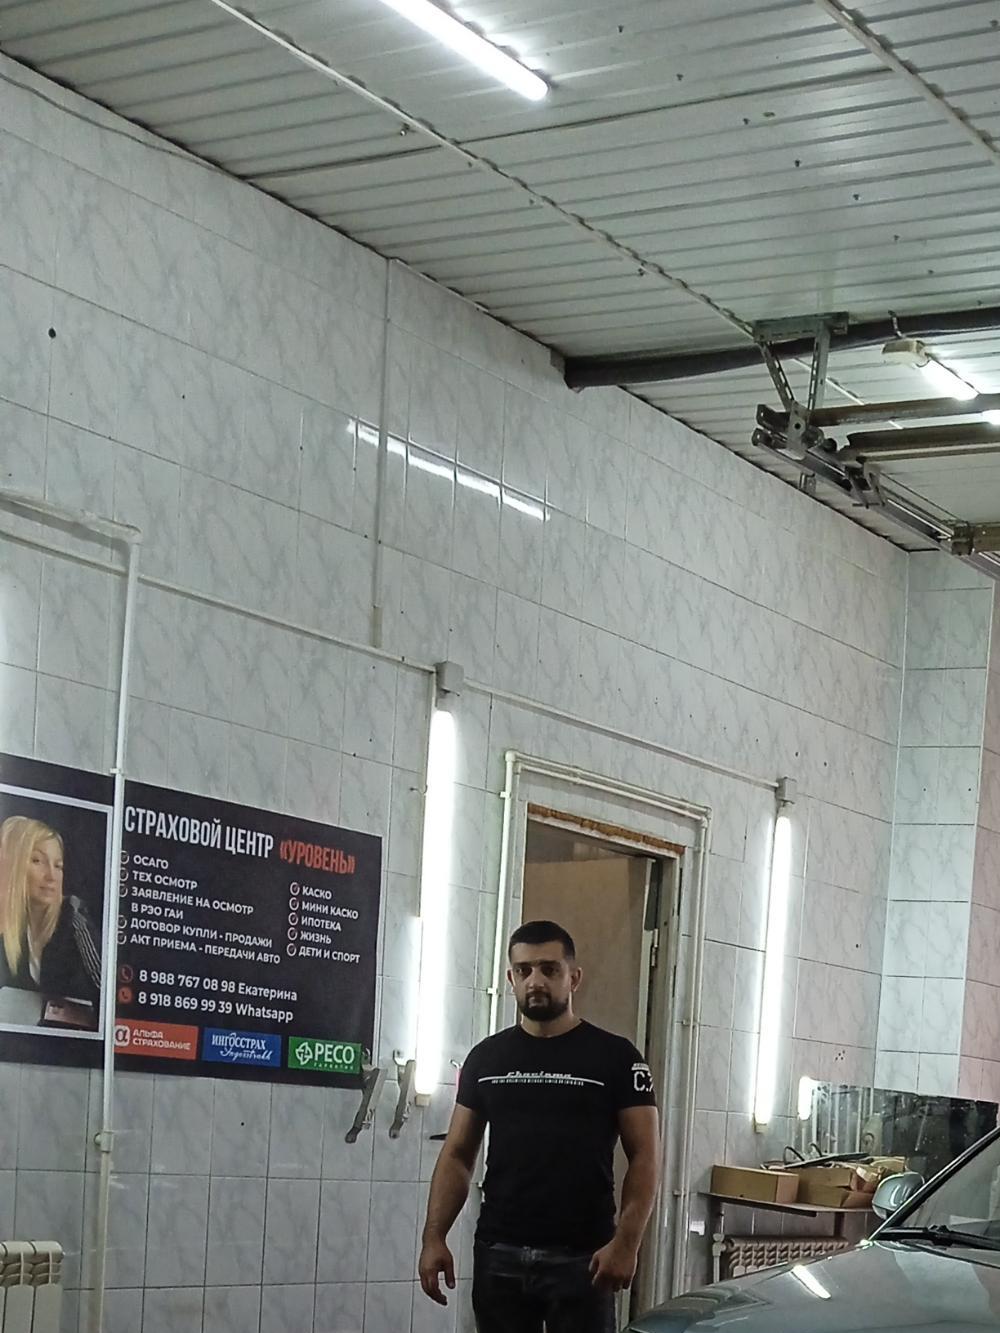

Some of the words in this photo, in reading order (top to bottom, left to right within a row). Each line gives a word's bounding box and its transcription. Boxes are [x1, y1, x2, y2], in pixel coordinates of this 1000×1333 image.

[124, 806, 221, 849] СТРАХОВОЙ
[225, 826, 274, 859] ЦЕНТР
[133, 855, 169, 869] ОСАГО
[132, 870, 152, 883] ТЕХ
[154, 875, 197, 890] ОСМОТР
[131, 886, 193, 906] ЗАЯВЛЕНИЕ
[196, 897, 210, 908] НА
[212, 900, 254, 915] ОСМОТР
[302, 886, 332, 899] КАСКО
[131, 902, 138, 912] В
[141, 904, 162, 916] РЭО
[164, 908, 183, 919] ГАИ
[301, 901, 328, 915] МИНИ
[330, 906, 358, 919] КАСКО
[130, 918, 181, 933] ДОГОВОР
[182, 925, 217, 940] КУПЛИ
[225, 932, 272, 948] ПРОДАЖИ
[301, 916, 341, 931] ИПОТЕКА
[300, 931, 331, 944] ЖИЗНЬ
[130, 934, 151, 945] АКТ
[153, 937, 196, 952] ПРИЕМА
[205, 944, 255, 960] ПЕРЕДАЧИ
[256, 950, 280, 964] АВТО
[299, 946, 322, 958] ДЕТИ
[324, 949, 330, 959] И
[332, 951, 360, 963] СПОРТ
[139, 970, 147, 982] 8
[151, 971, 175, 985] 988
[178, 975, 200, 988] 767
[203, 977, 218, 991] 08
[221, 980, 235, 993] 98
[238, 983, 297, 1001] Екатерина
[138, 992, 146, 1004] 8
[150, 993, 171, 1006] 918
[174, 996, 198, 1009] 869
[201, 999, 216, 1012] 99
[218, 1001, 232, 1014] 39
[236, 1003, 293, 1023] Whatsapp
[211, 1032, 266, 1050] ИНГОССТРАХ
[314, 1043, 355, 1064] РЕСО
